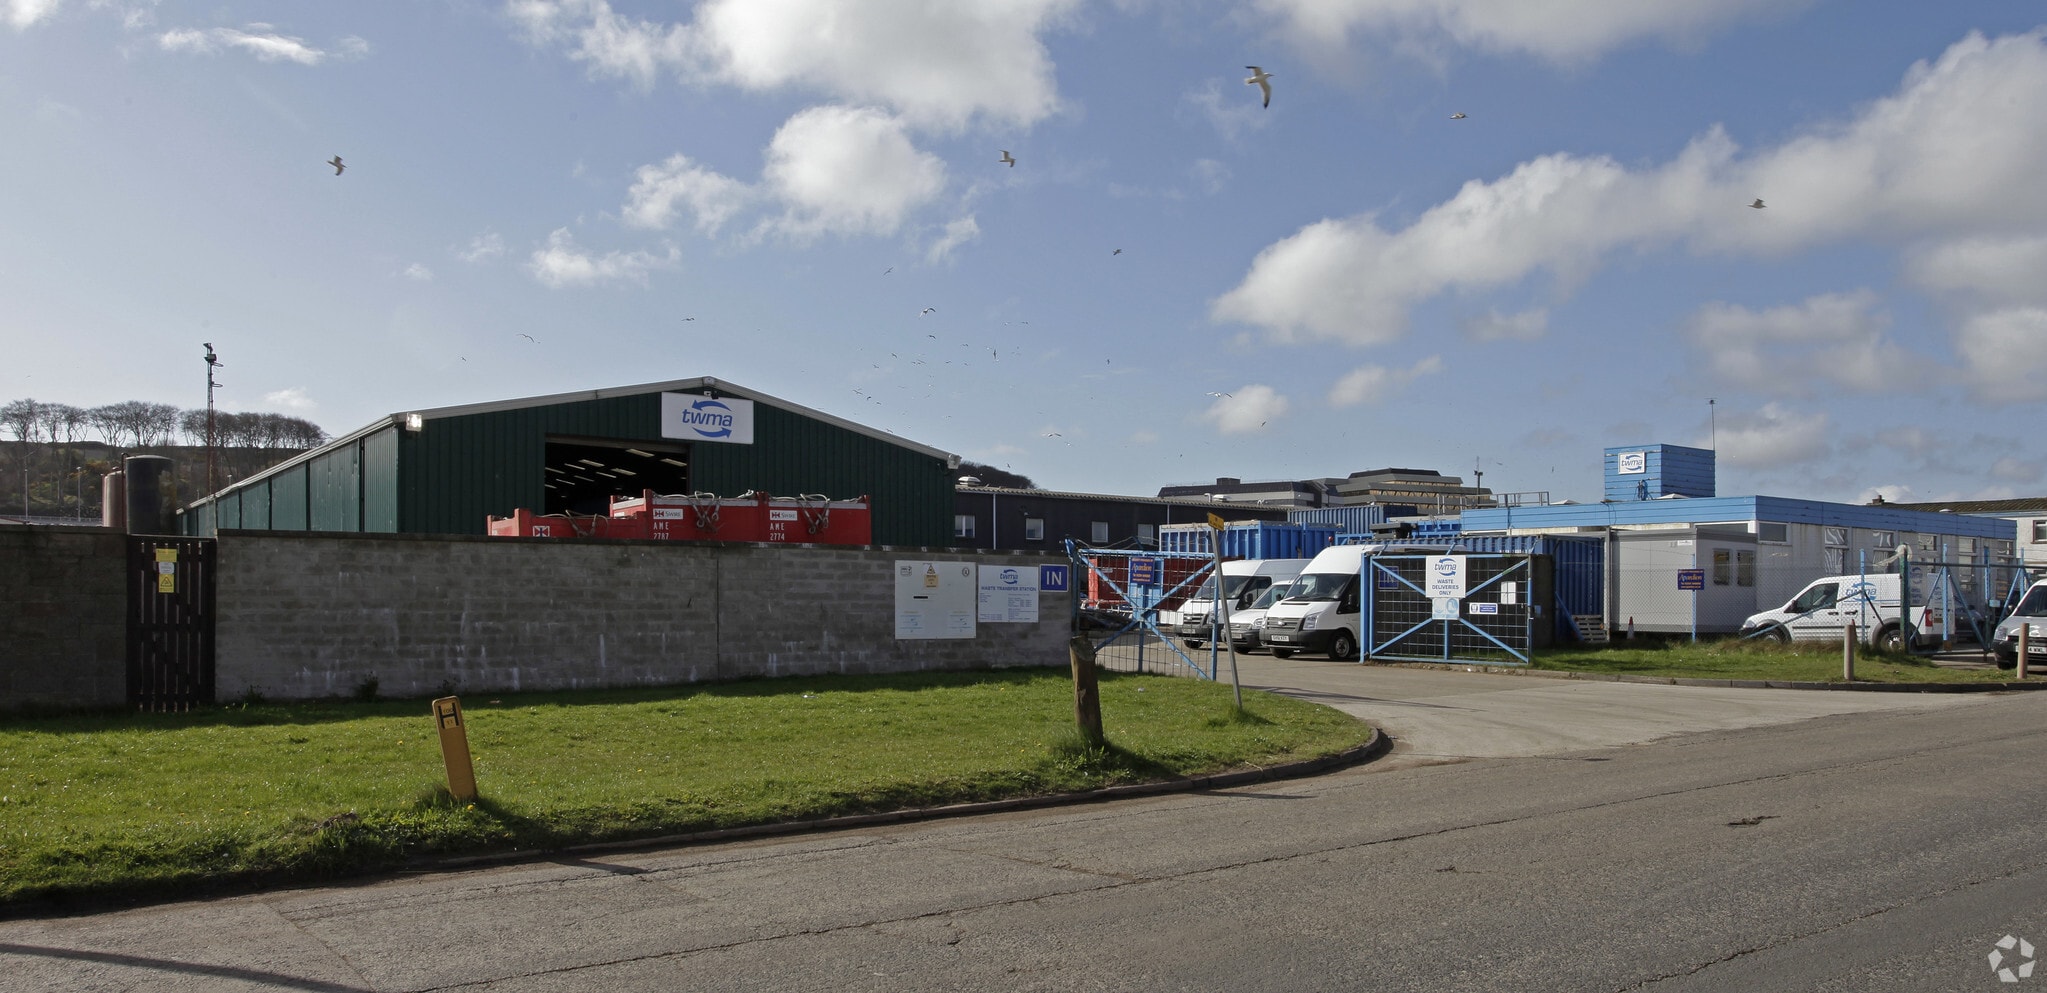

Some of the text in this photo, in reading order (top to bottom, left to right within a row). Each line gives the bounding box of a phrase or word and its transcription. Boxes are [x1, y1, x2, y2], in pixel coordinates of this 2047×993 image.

[682, 408, 733, 427] twma
[1621, 459, 1642, 467] twma
[769, 532, 785, 541] 2774
[1434, 563, 1457, 571] twma
[1046, 570, 1062, 586] IN
